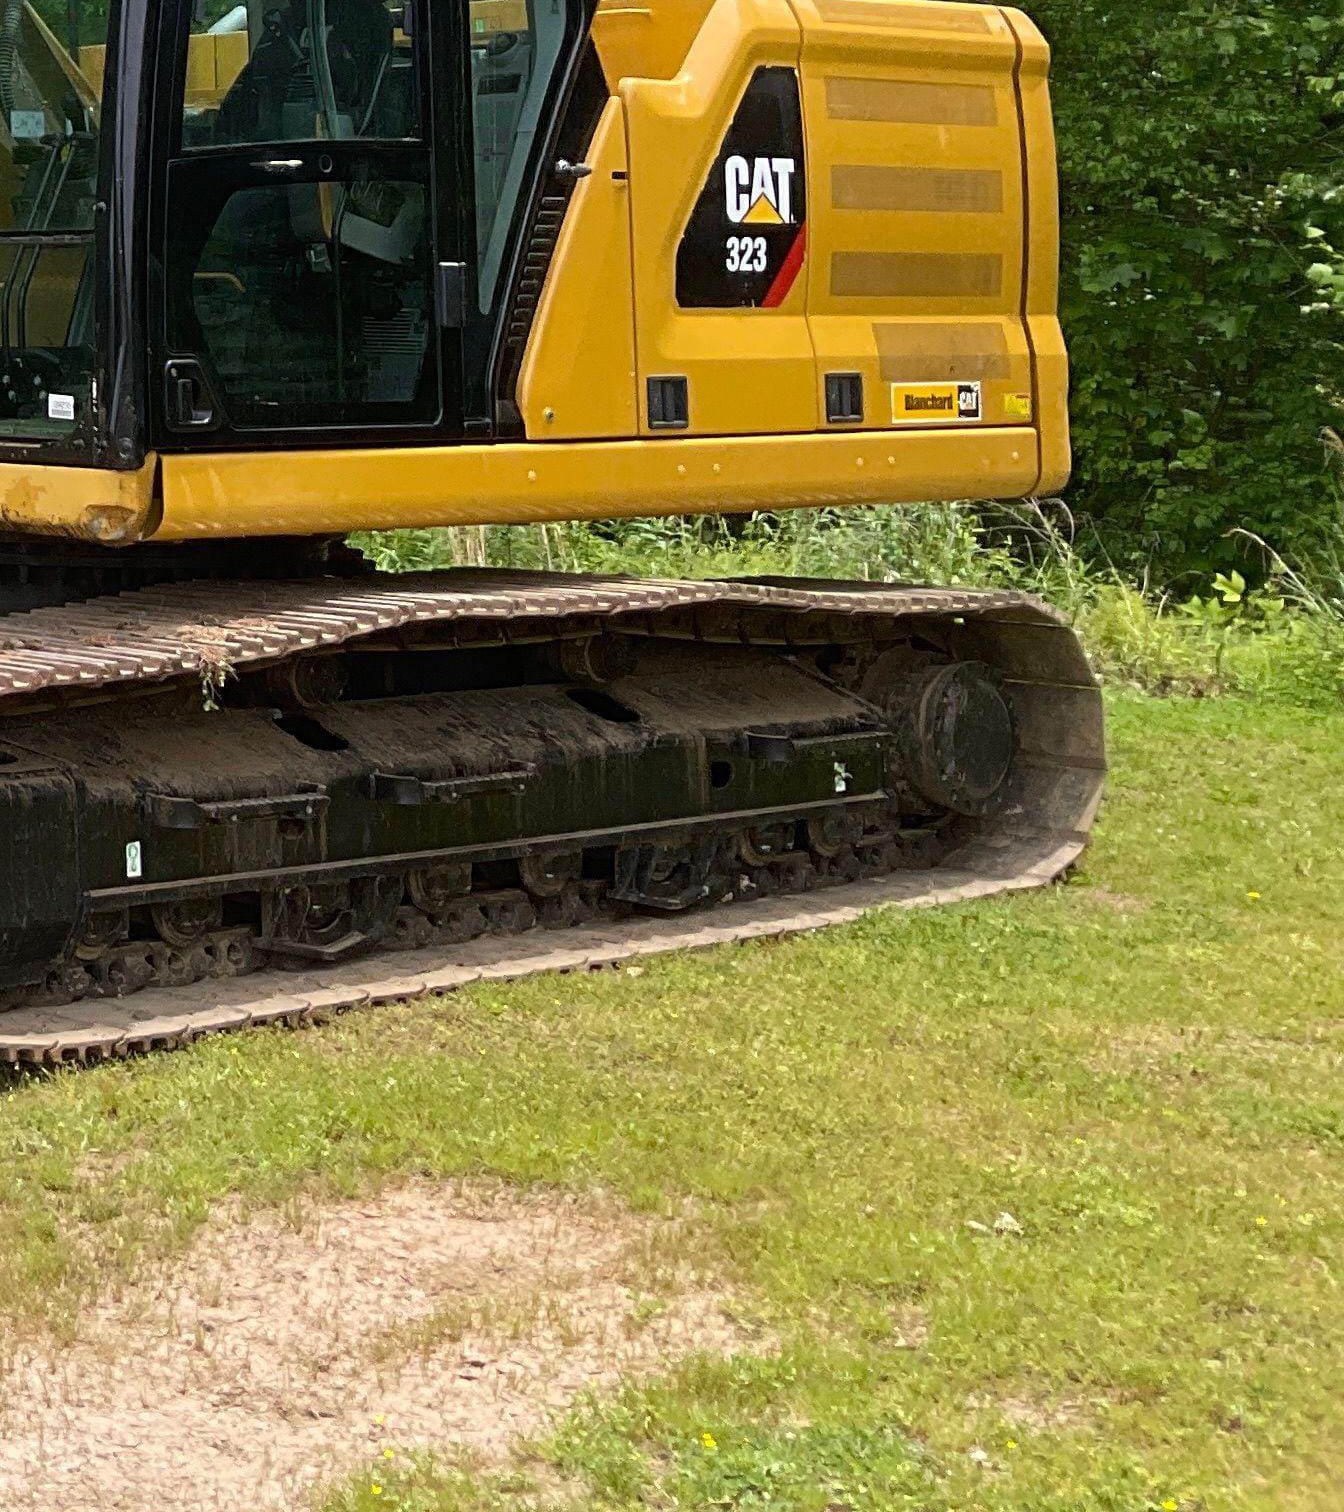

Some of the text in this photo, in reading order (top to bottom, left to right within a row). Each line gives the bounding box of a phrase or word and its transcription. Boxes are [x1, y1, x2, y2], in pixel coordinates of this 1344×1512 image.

[725, 155, 795, 224] CAT
[725, 236, 767, 272] 323
[904, 390, 978, 411] Blanchard CAT
